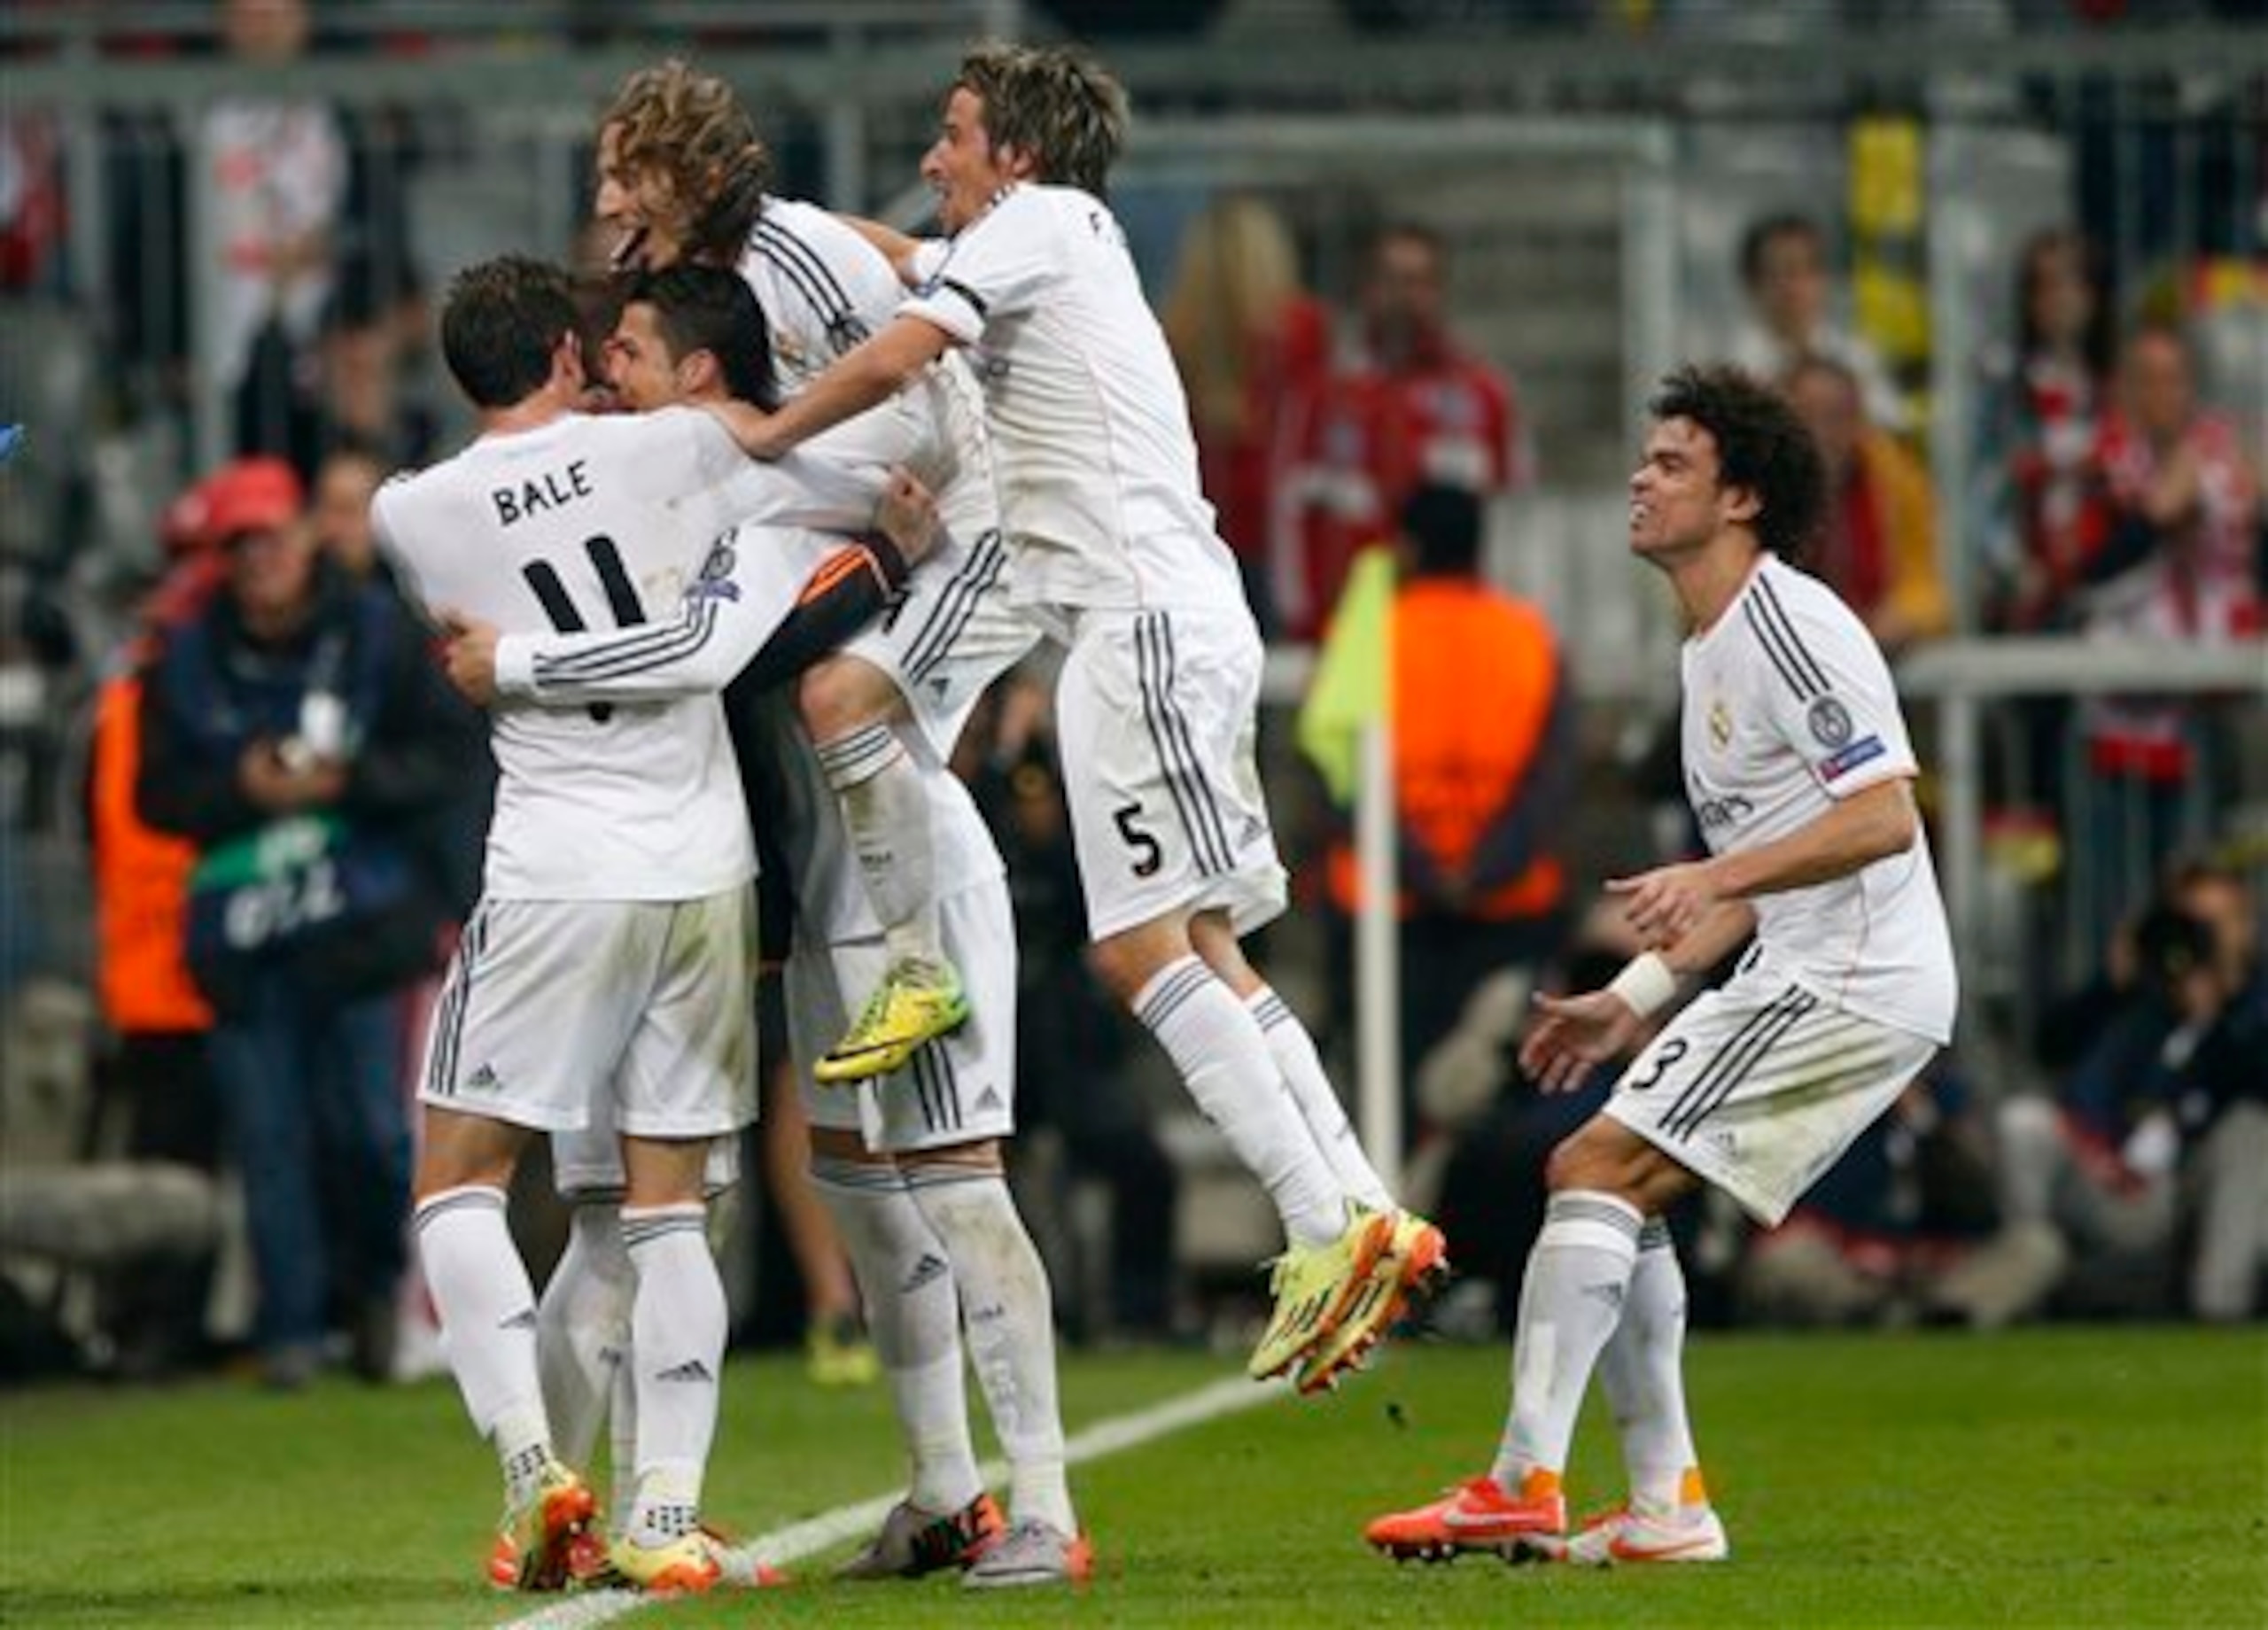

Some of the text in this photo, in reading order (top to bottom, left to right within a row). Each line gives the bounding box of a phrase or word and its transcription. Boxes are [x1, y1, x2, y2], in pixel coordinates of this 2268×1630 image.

[493, 458, 594, 525] BALE
[1112, 801, 1162, 877] 5
[1631, 1039, 1687, 1091] 3
